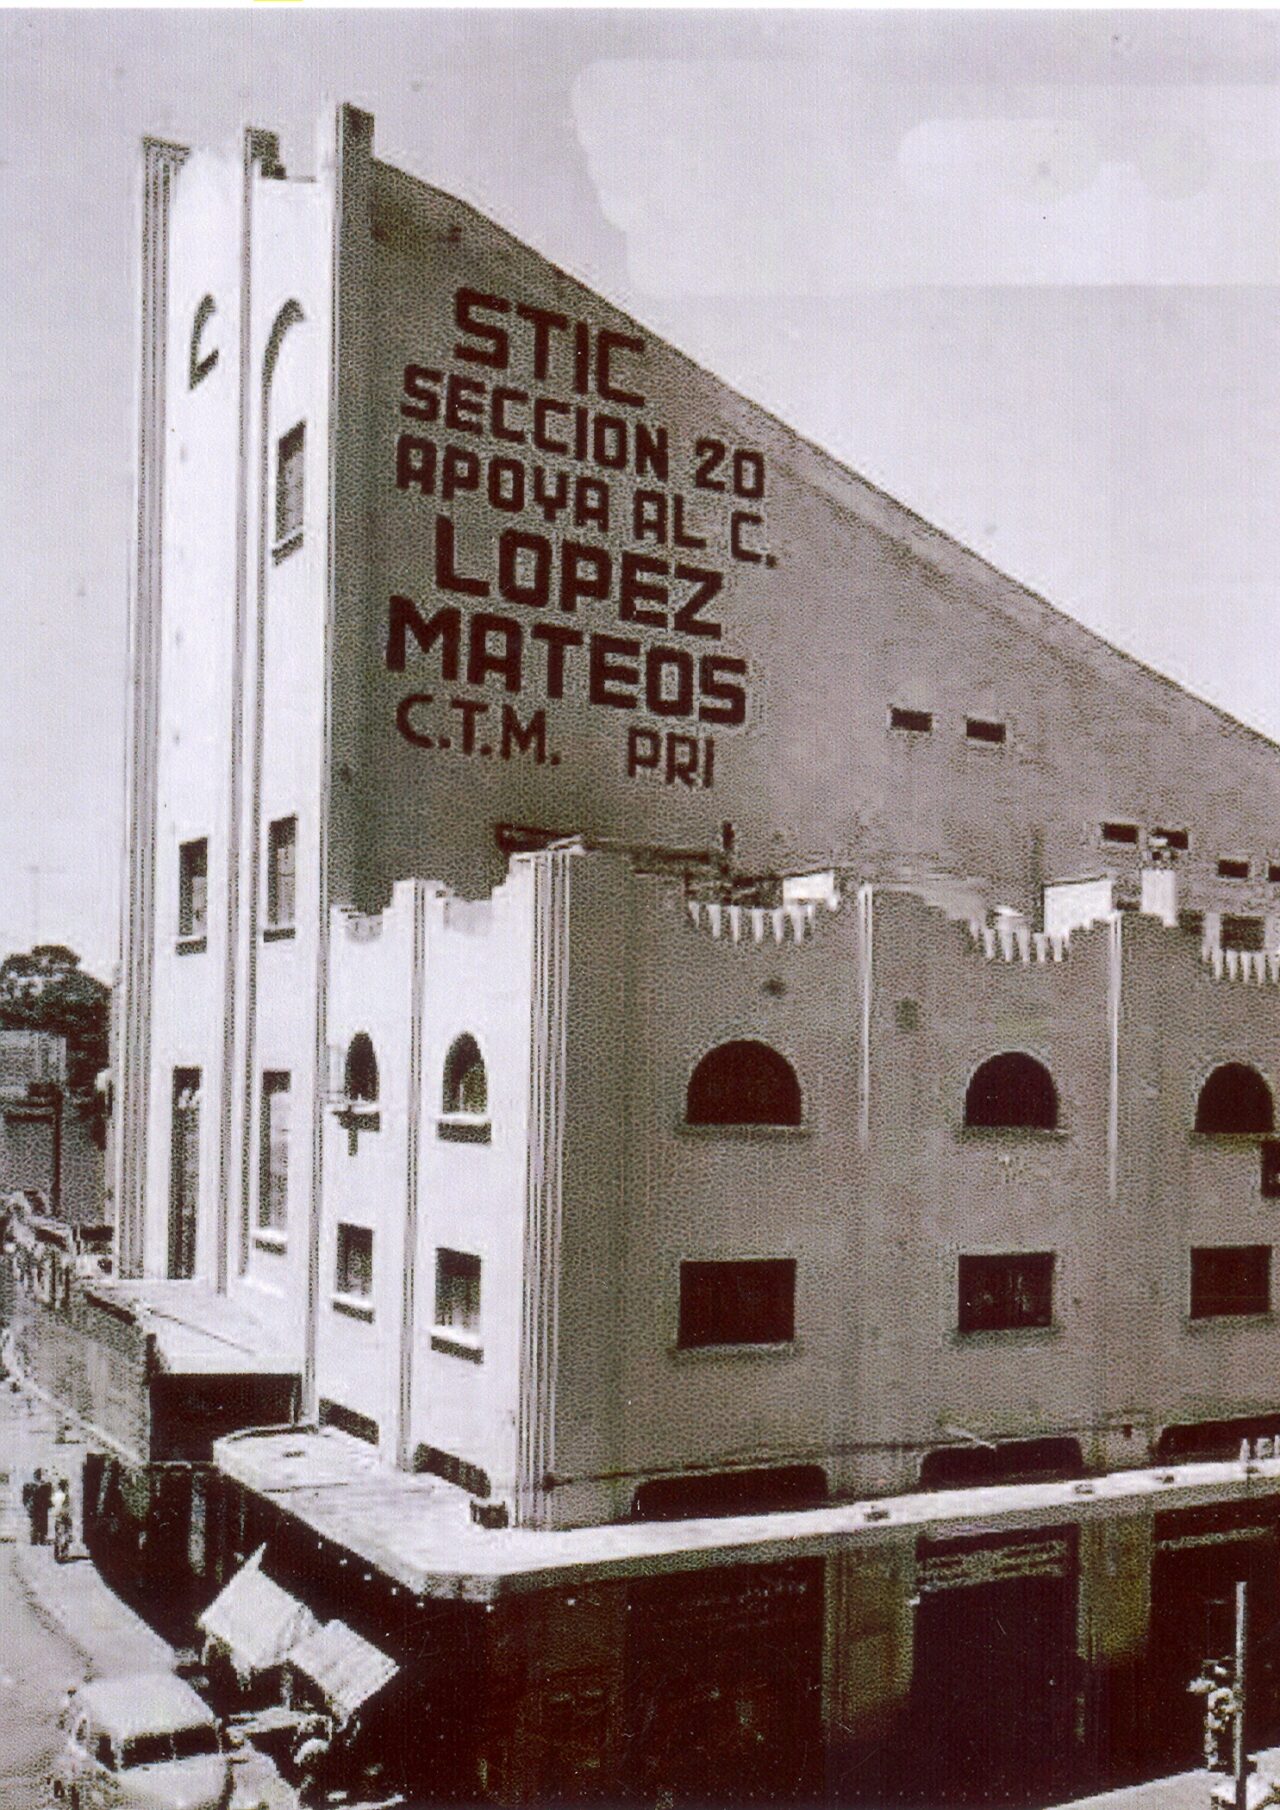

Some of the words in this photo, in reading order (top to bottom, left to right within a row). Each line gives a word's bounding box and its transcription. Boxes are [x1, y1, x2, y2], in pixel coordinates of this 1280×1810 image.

[453, 287, 645, 408] STIC
[402, 363, 669, 481] SECCION
[696, 437, 766, 500] 20
[396, 433, 609, 533] APOYA
[633, 488, 707, 548] AL
[730, 511, 777, 568] C.
[435, 513, 722, 640] LOPEZ
[385, 594, 747, 726] MATEOS
[395, 693, 561, 766] C.T.M.
[626, 725, 715, 790] PRI
